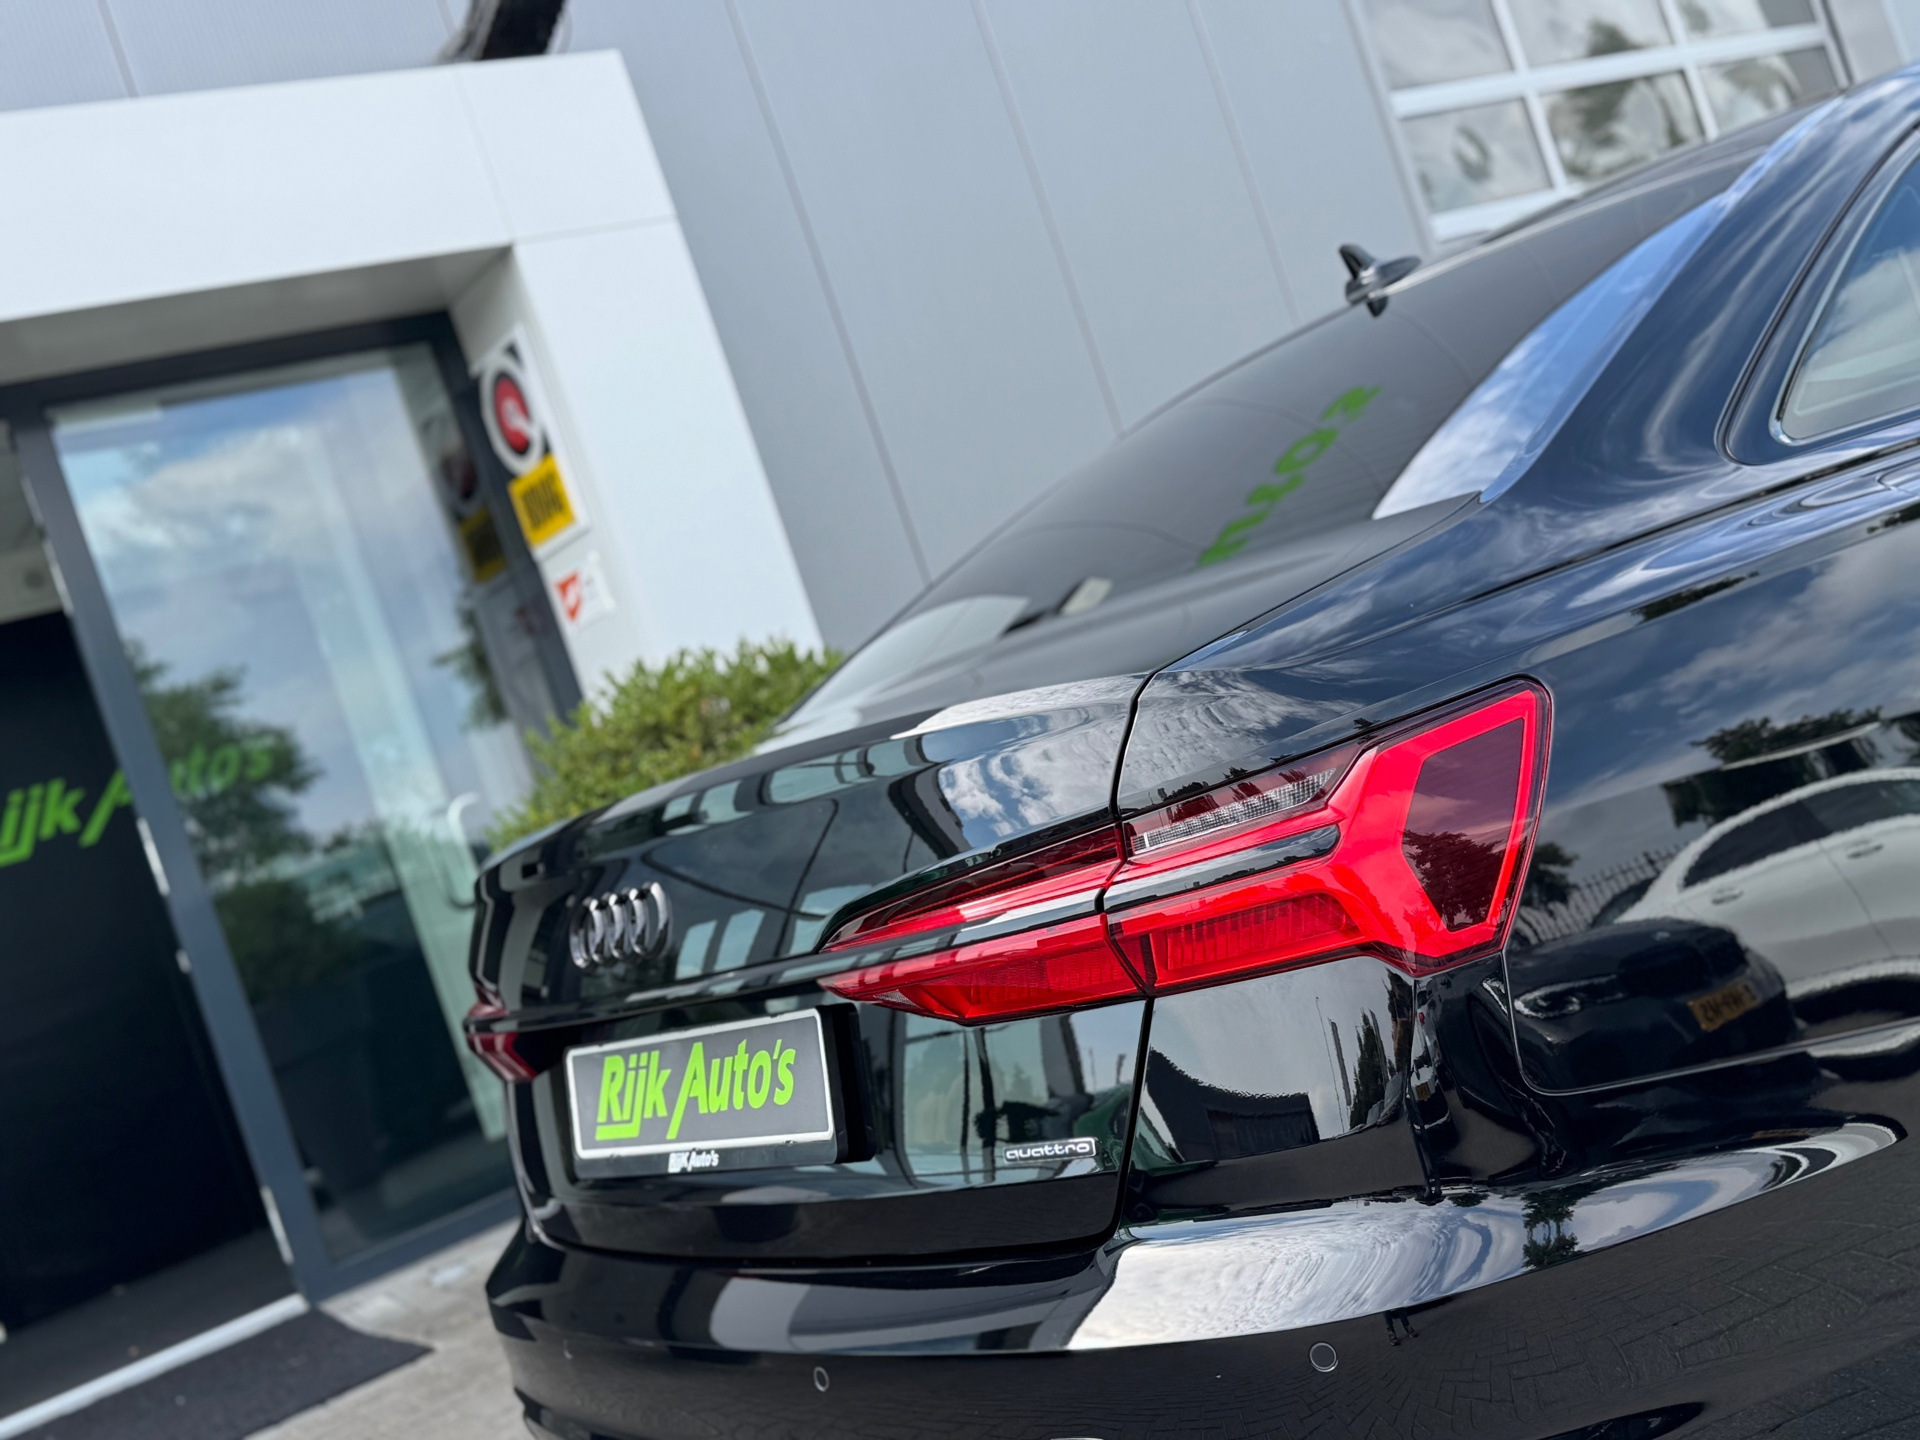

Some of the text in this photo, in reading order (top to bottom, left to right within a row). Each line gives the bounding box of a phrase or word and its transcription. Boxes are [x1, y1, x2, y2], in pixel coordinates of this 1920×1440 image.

[0, 778, 85, 867] ijk
[595, 1038, 797, 1141] Rijk Auto's
[1006, 1143, 1090, 1160] quattro
